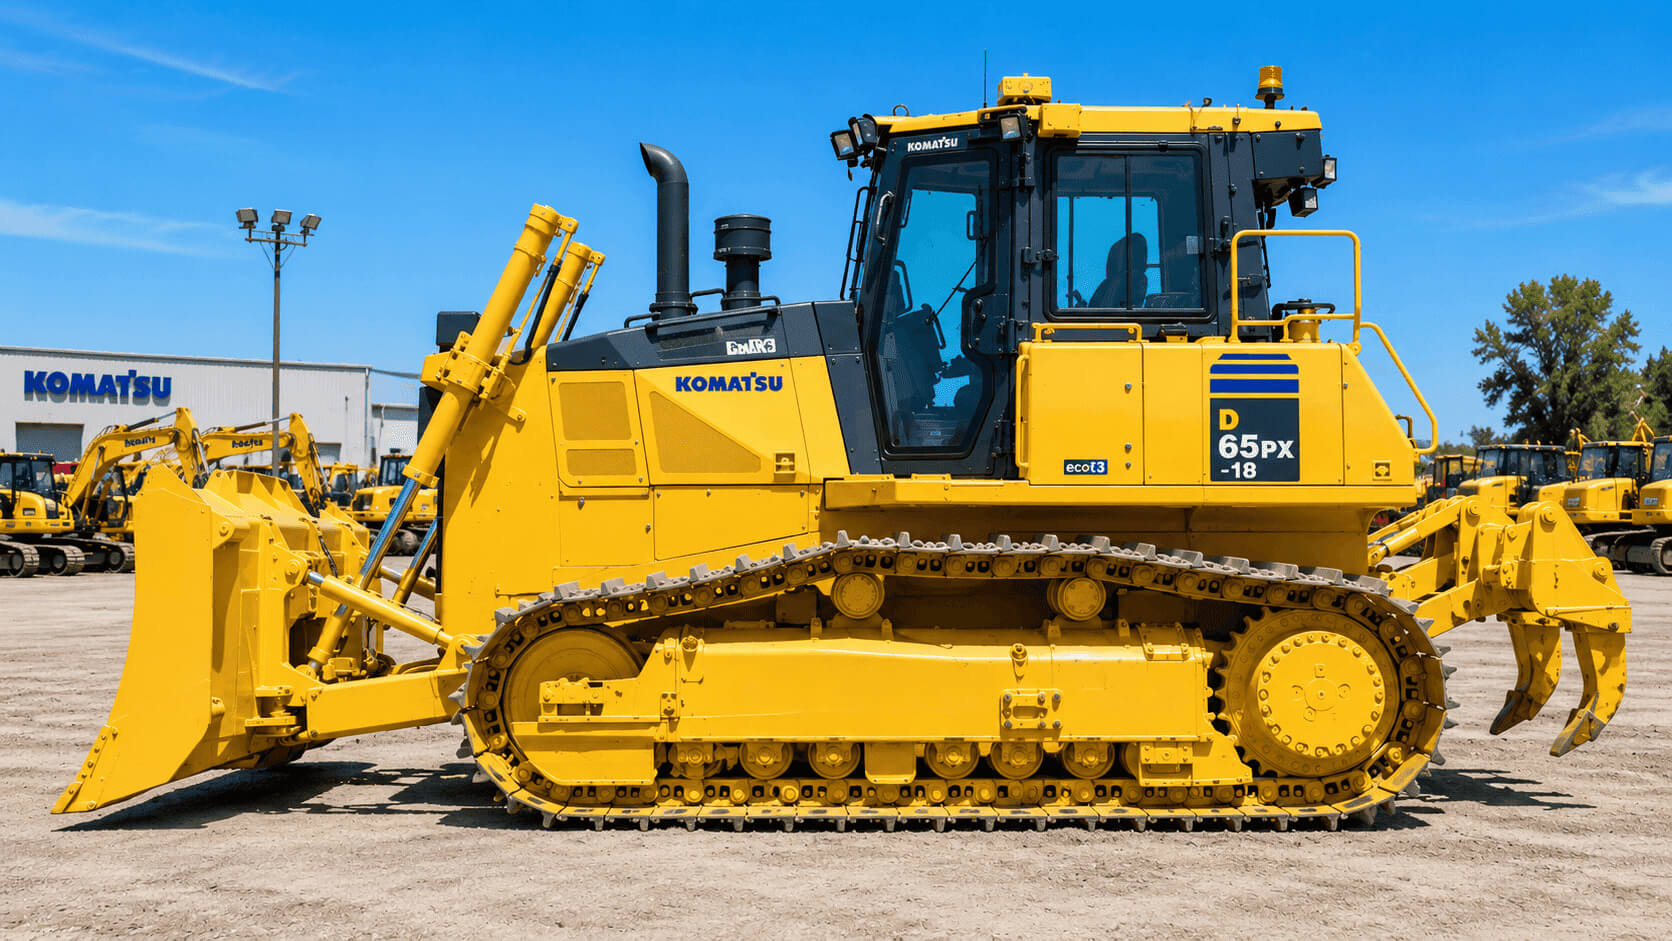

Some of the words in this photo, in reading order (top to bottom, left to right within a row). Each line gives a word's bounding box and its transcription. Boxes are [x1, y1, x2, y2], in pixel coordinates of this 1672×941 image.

[907, 136, 958, 152] KOMATSU
[24, 370, 171, 399] KOMATSU
[675, 372, 783, 392] KOMATSU
[1219, 409, 1239, 431] D
[1218, 434, 1295, 460] 65PX
[1221, 463, 1257, 480] -18
